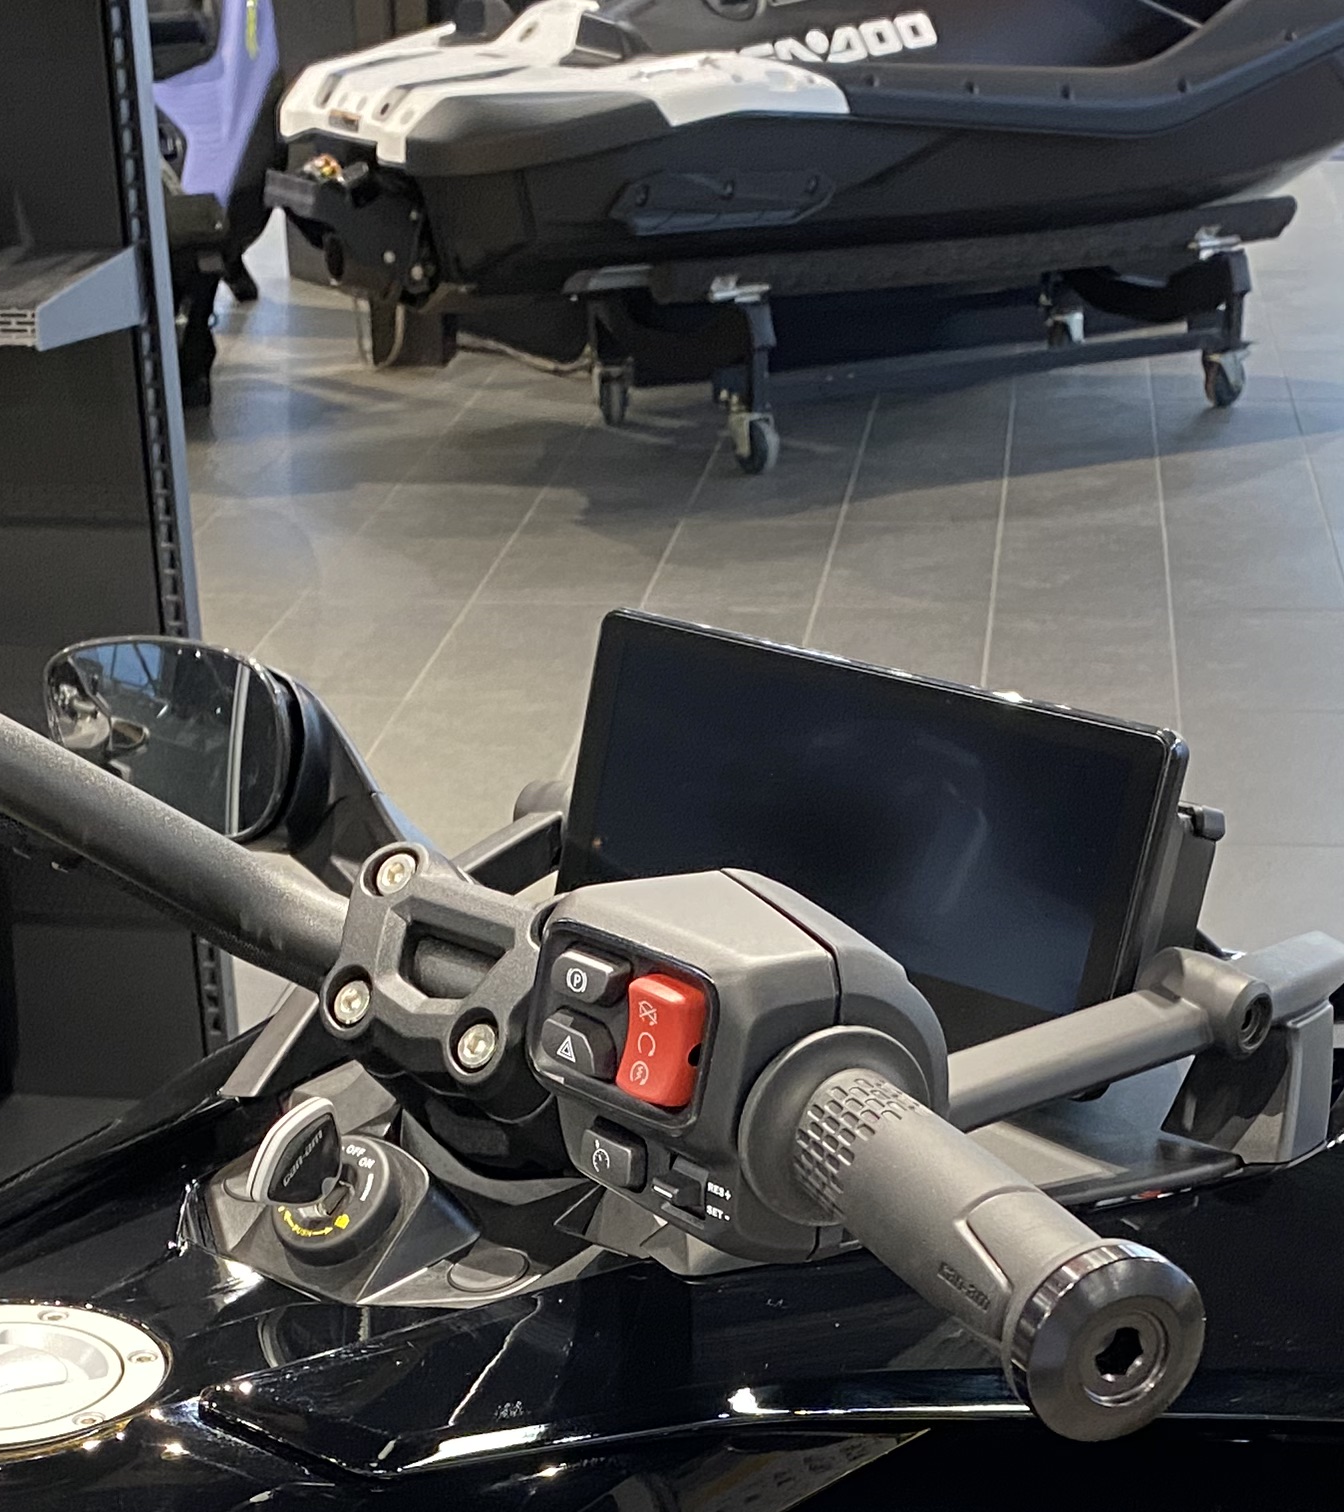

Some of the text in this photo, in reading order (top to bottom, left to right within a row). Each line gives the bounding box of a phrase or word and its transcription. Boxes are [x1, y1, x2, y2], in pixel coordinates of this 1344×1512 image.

[739, 11, 938, 63] A-DOO
[346, 1144, 366, 1157] OFF
[282, 1129, 323, 1187] can-am
[358, 1156, 376, 1169] ON
[292, 1224, 312, 1237] PUSH
